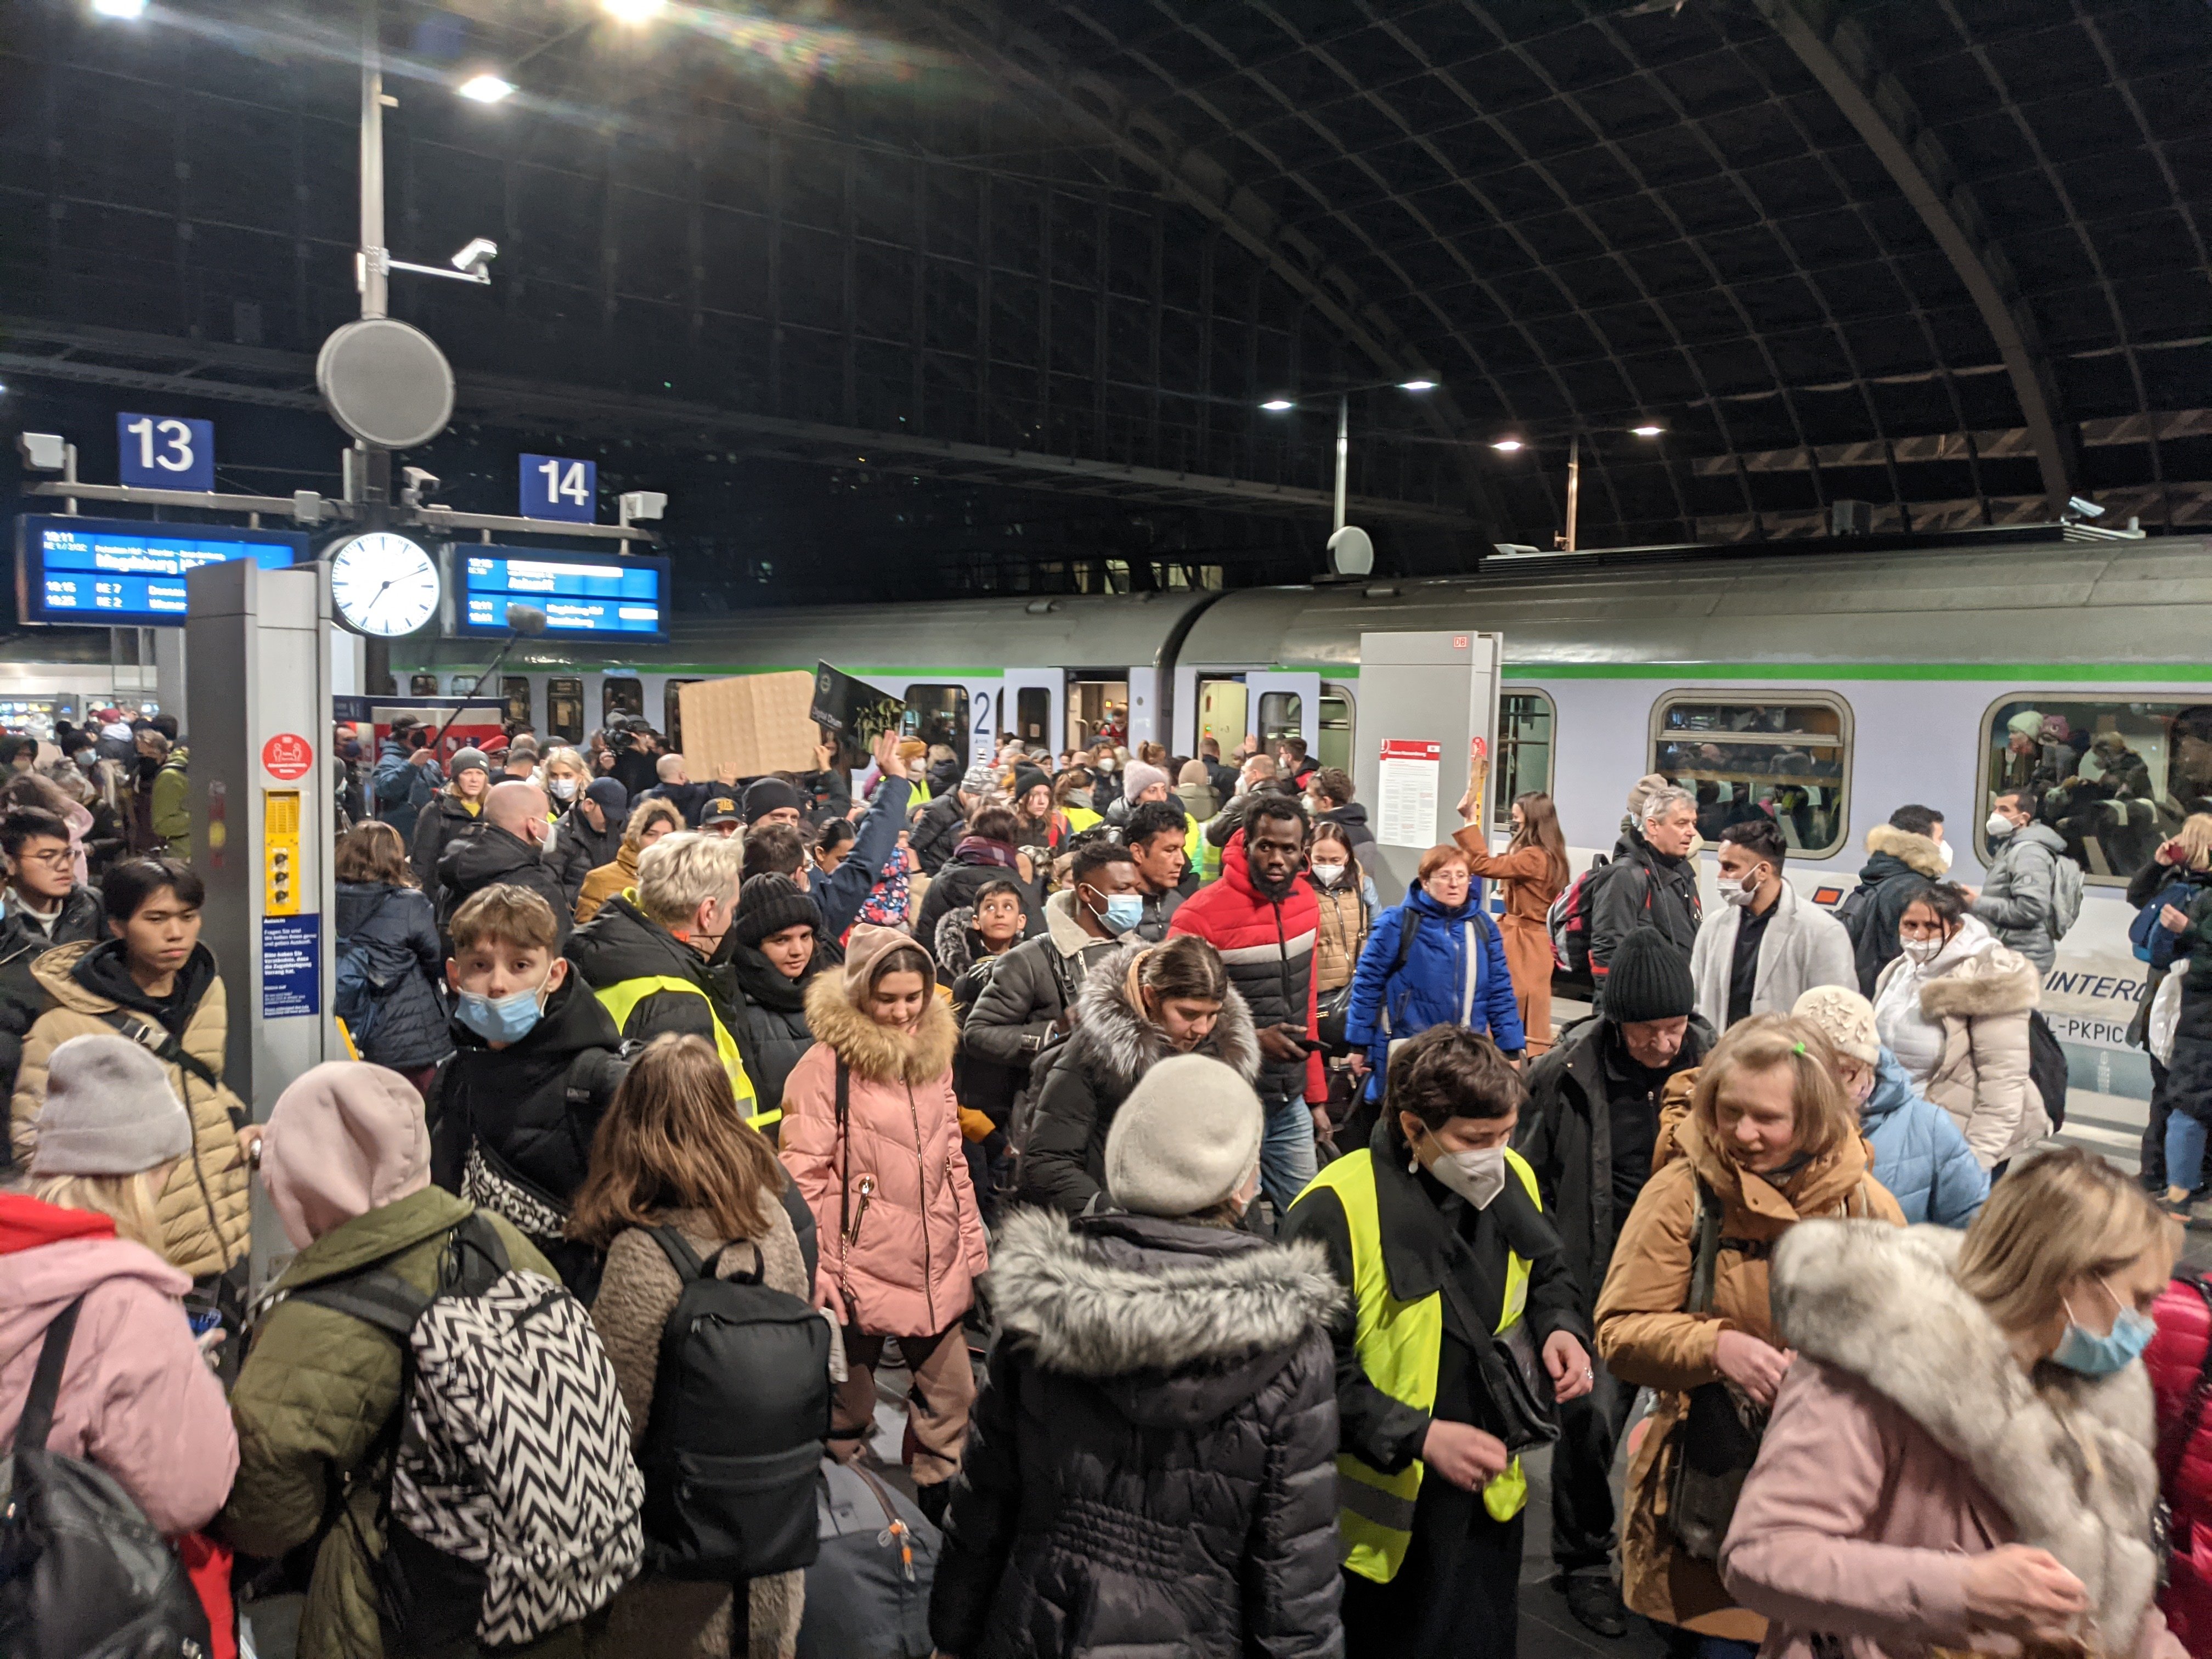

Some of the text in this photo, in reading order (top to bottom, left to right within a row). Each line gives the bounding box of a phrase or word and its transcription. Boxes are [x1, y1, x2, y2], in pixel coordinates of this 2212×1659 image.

[128, 418, 194, 472] 13
[539, 460, 589, 506] 14
[1454, 637, 1466, 647] DB
[974, 692, 990, 735] 2
